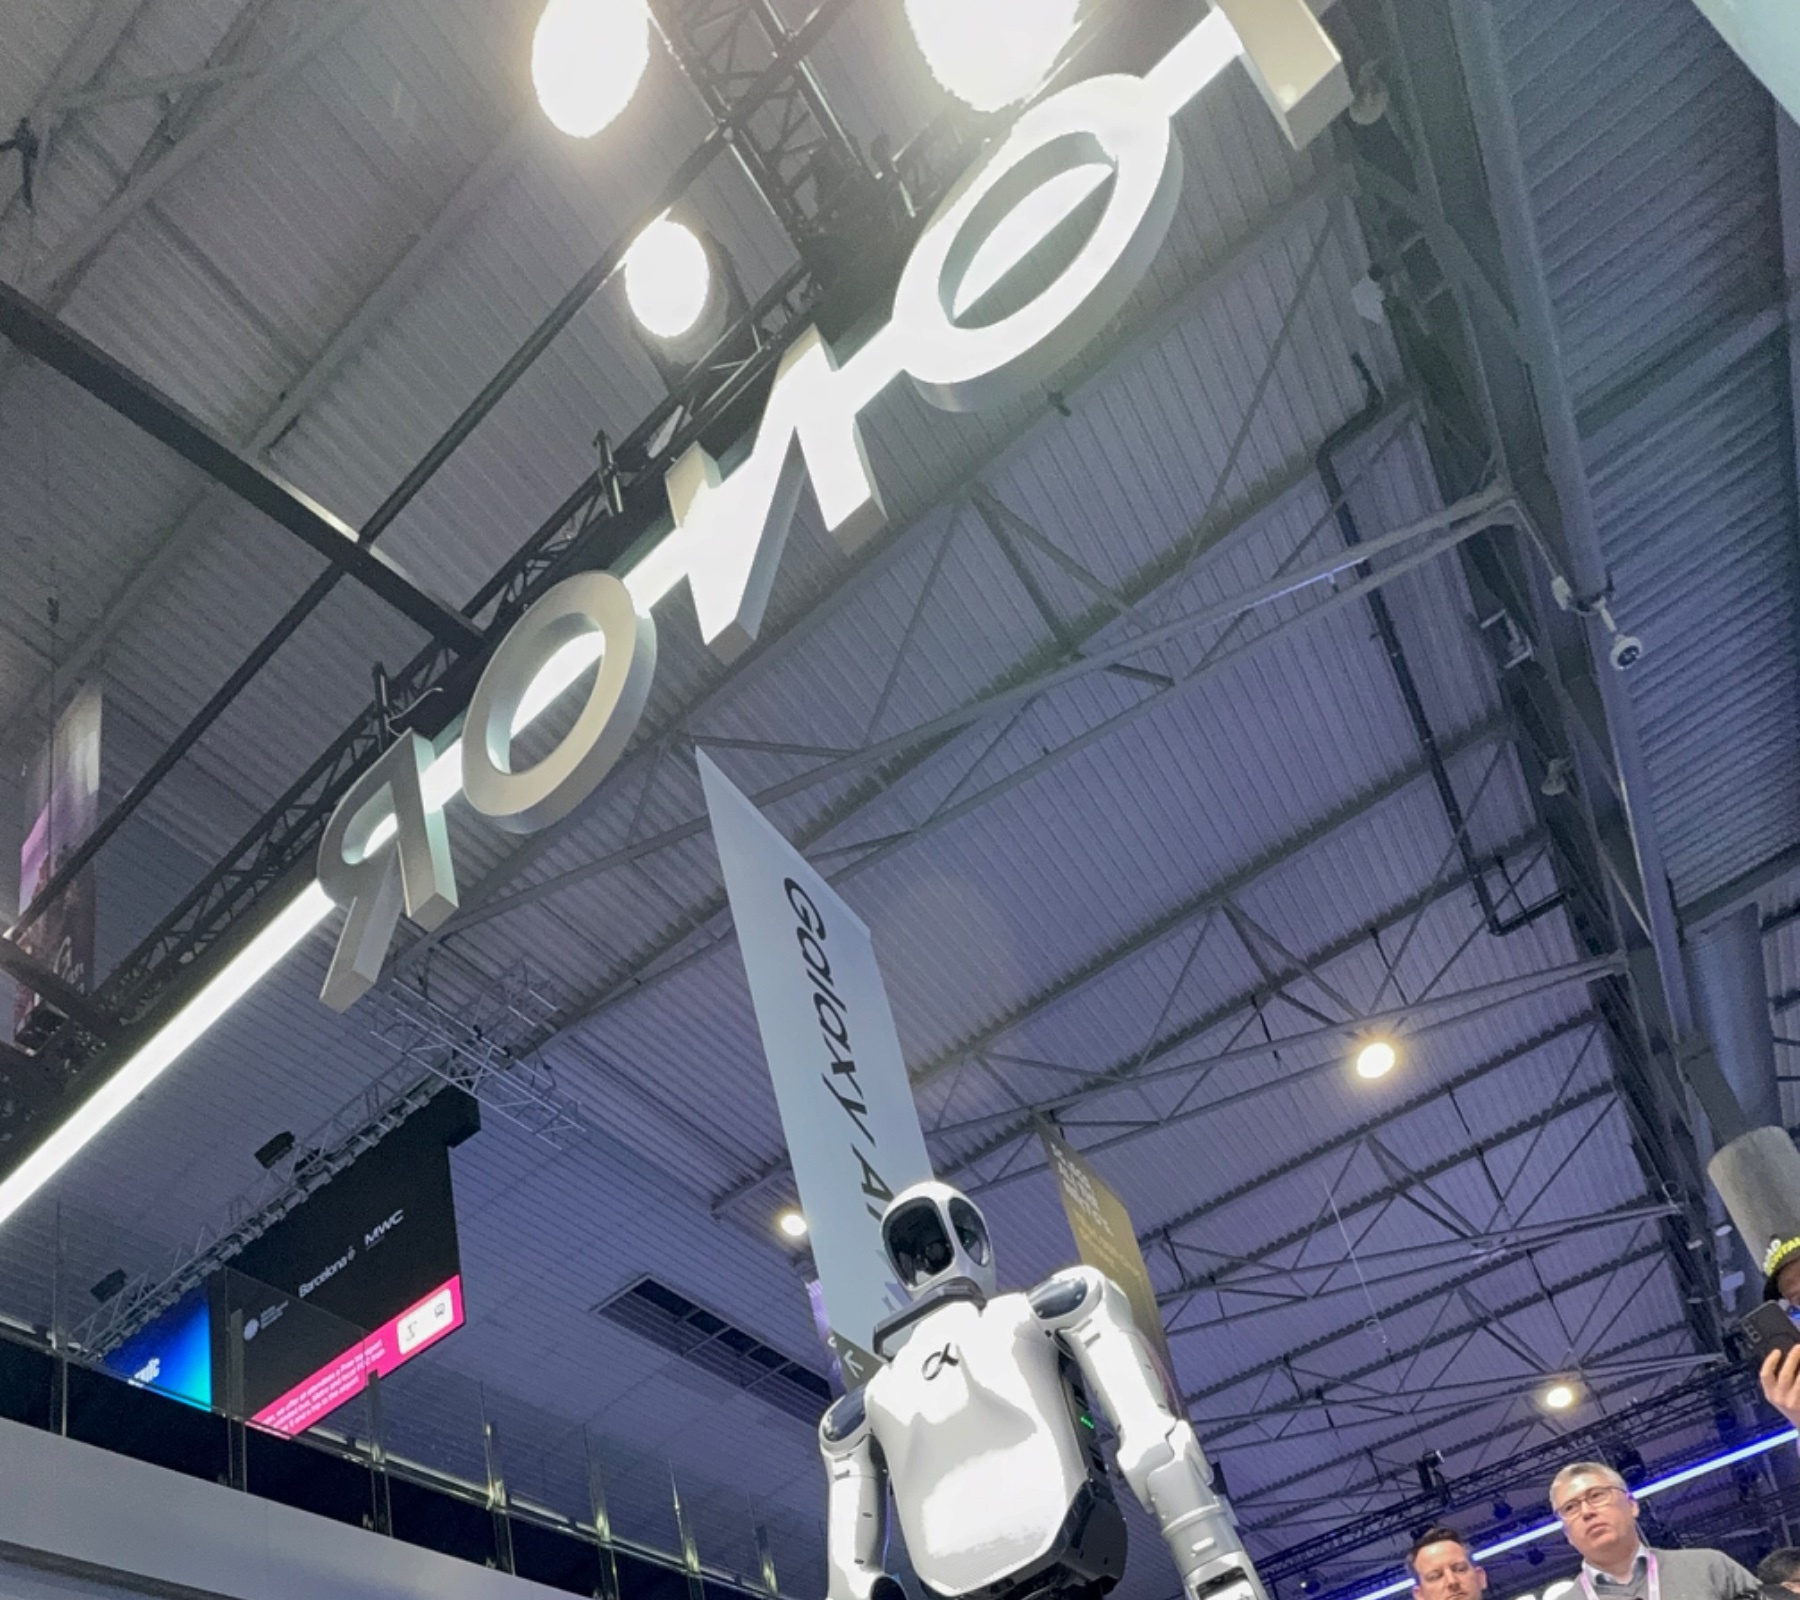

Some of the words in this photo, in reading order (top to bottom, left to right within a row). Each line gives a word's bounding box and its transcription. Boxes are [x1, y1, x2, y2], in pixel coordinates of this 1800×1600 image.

[784, 877, 876, 1147] Galaxy
[364, 1209, 404, 1246] MWC
[299, 1256, 347, 1298] Barcelona
